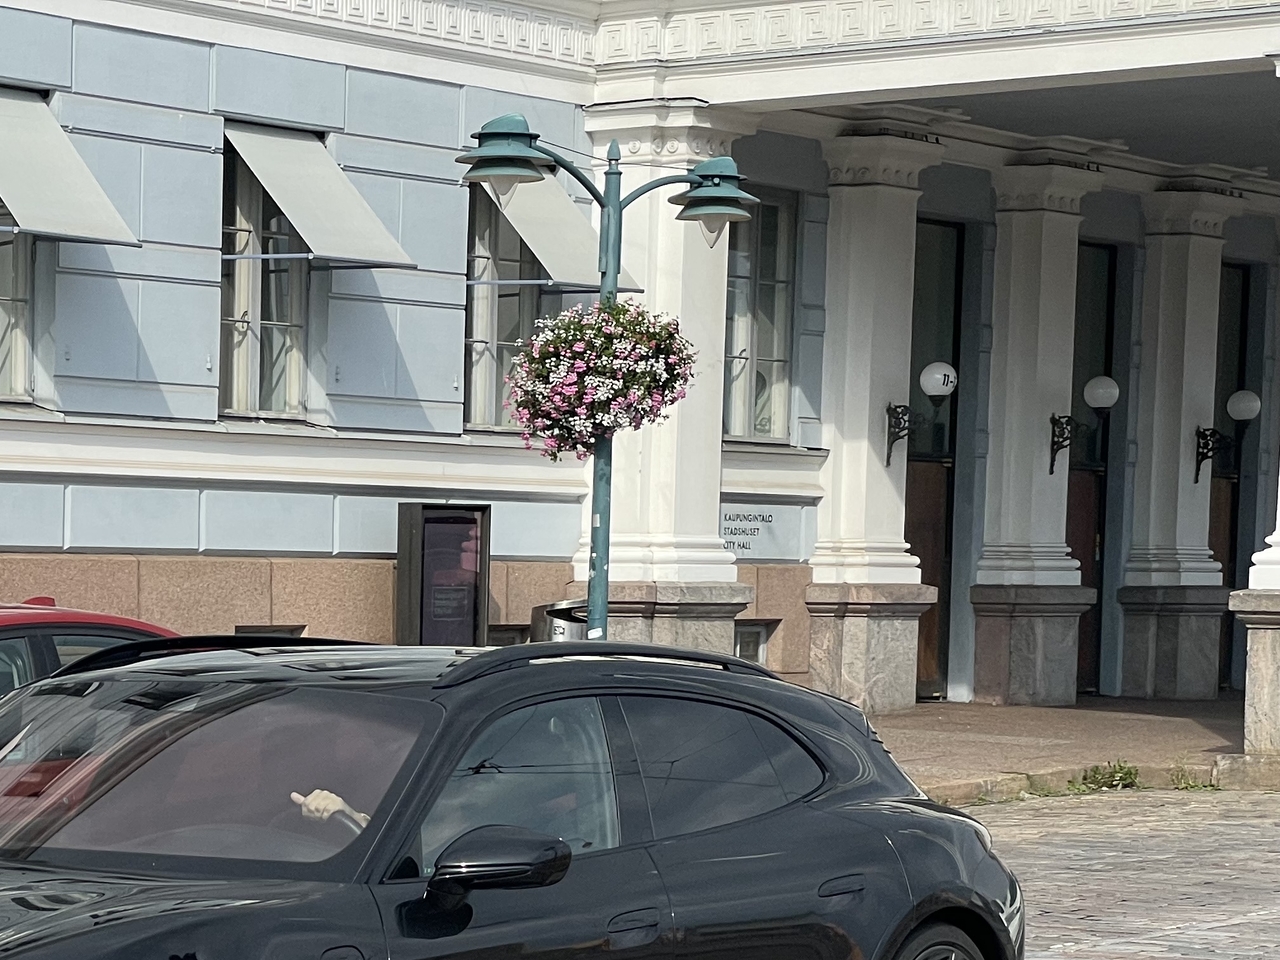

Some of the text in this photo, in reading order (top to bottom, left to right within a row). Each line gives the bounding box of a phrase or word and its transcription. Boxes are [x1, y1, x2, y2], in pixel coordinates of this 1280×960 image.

[723, 513, 773, 523] KAUPUNGINTALO
[723, 527, 760, 536] STADSHUSET
[723, 541, 752, 550] CITY HALL
